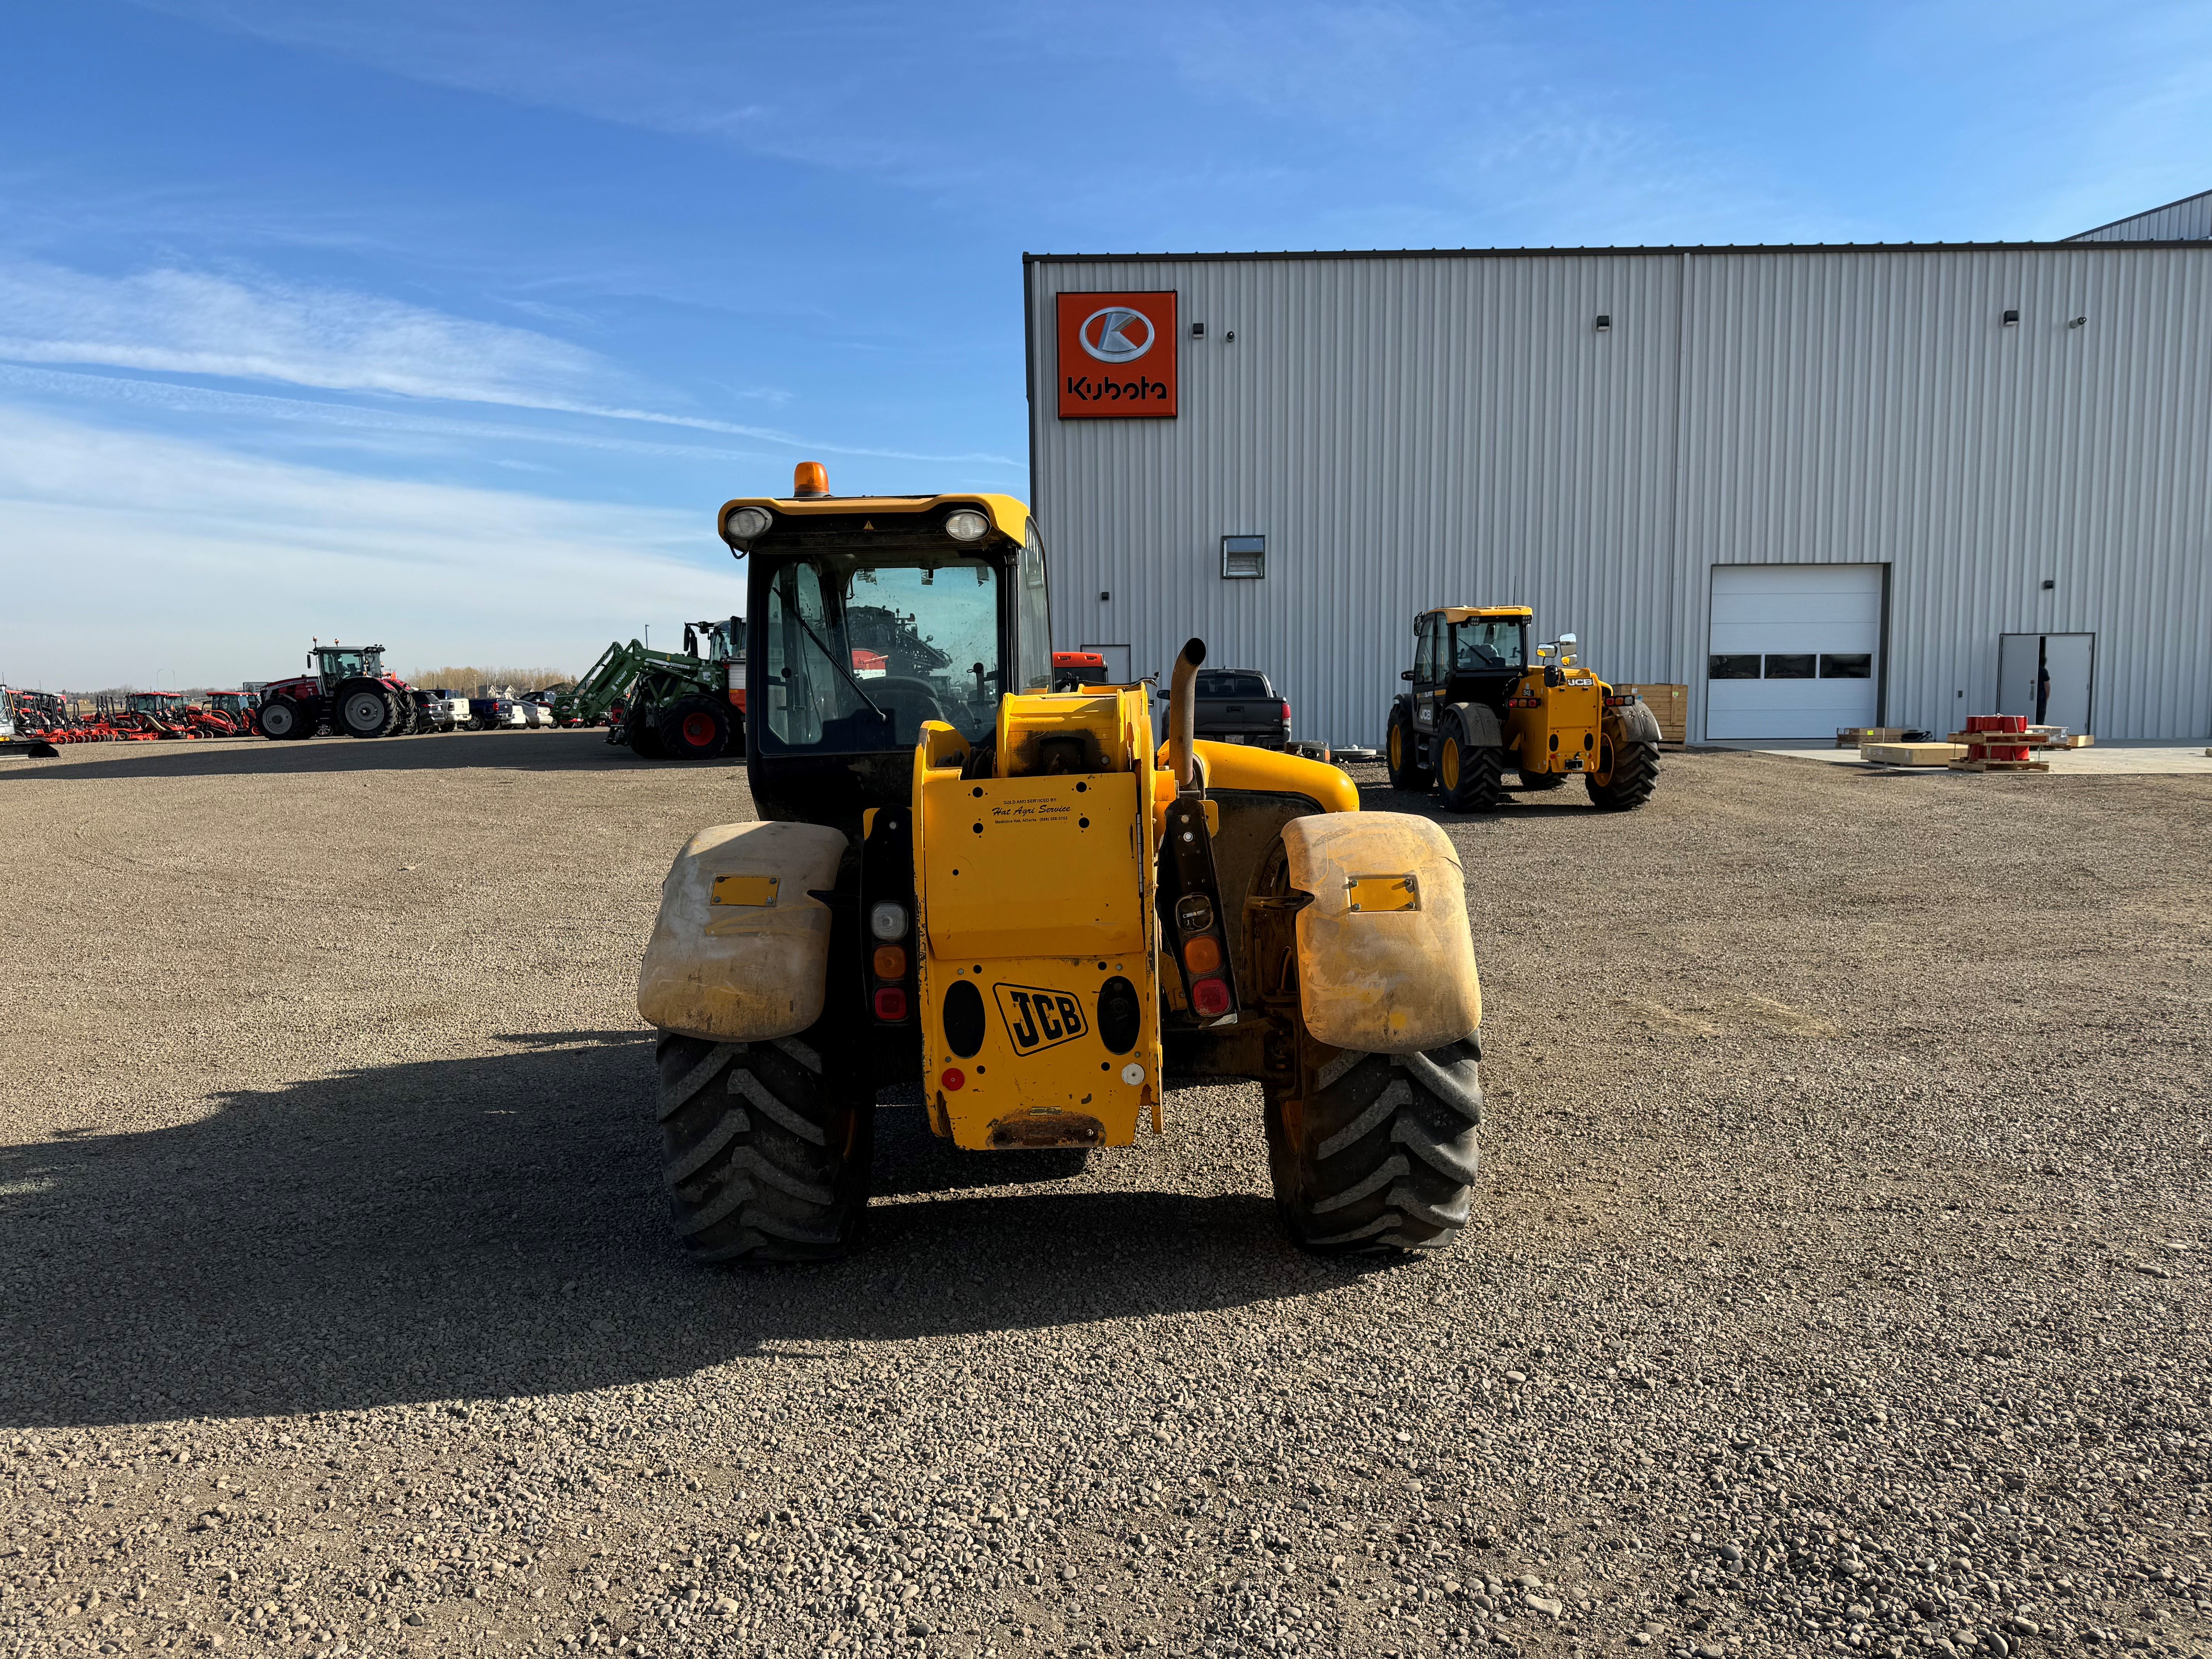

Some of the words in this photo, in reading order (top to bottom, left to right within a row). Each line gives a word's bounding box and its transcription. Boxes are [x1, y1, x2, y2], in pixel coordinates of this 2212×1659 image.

[1068, 376, 1167, 400] Kubota
[1420, 709, 1431, 720] JCB
[992, 807, 1011, 816] Hat
[1013, 806, 1035, 817] Agri
[1038, 804, 1071, 813] Service
[1010, 991, 1082, 1048] JCB
